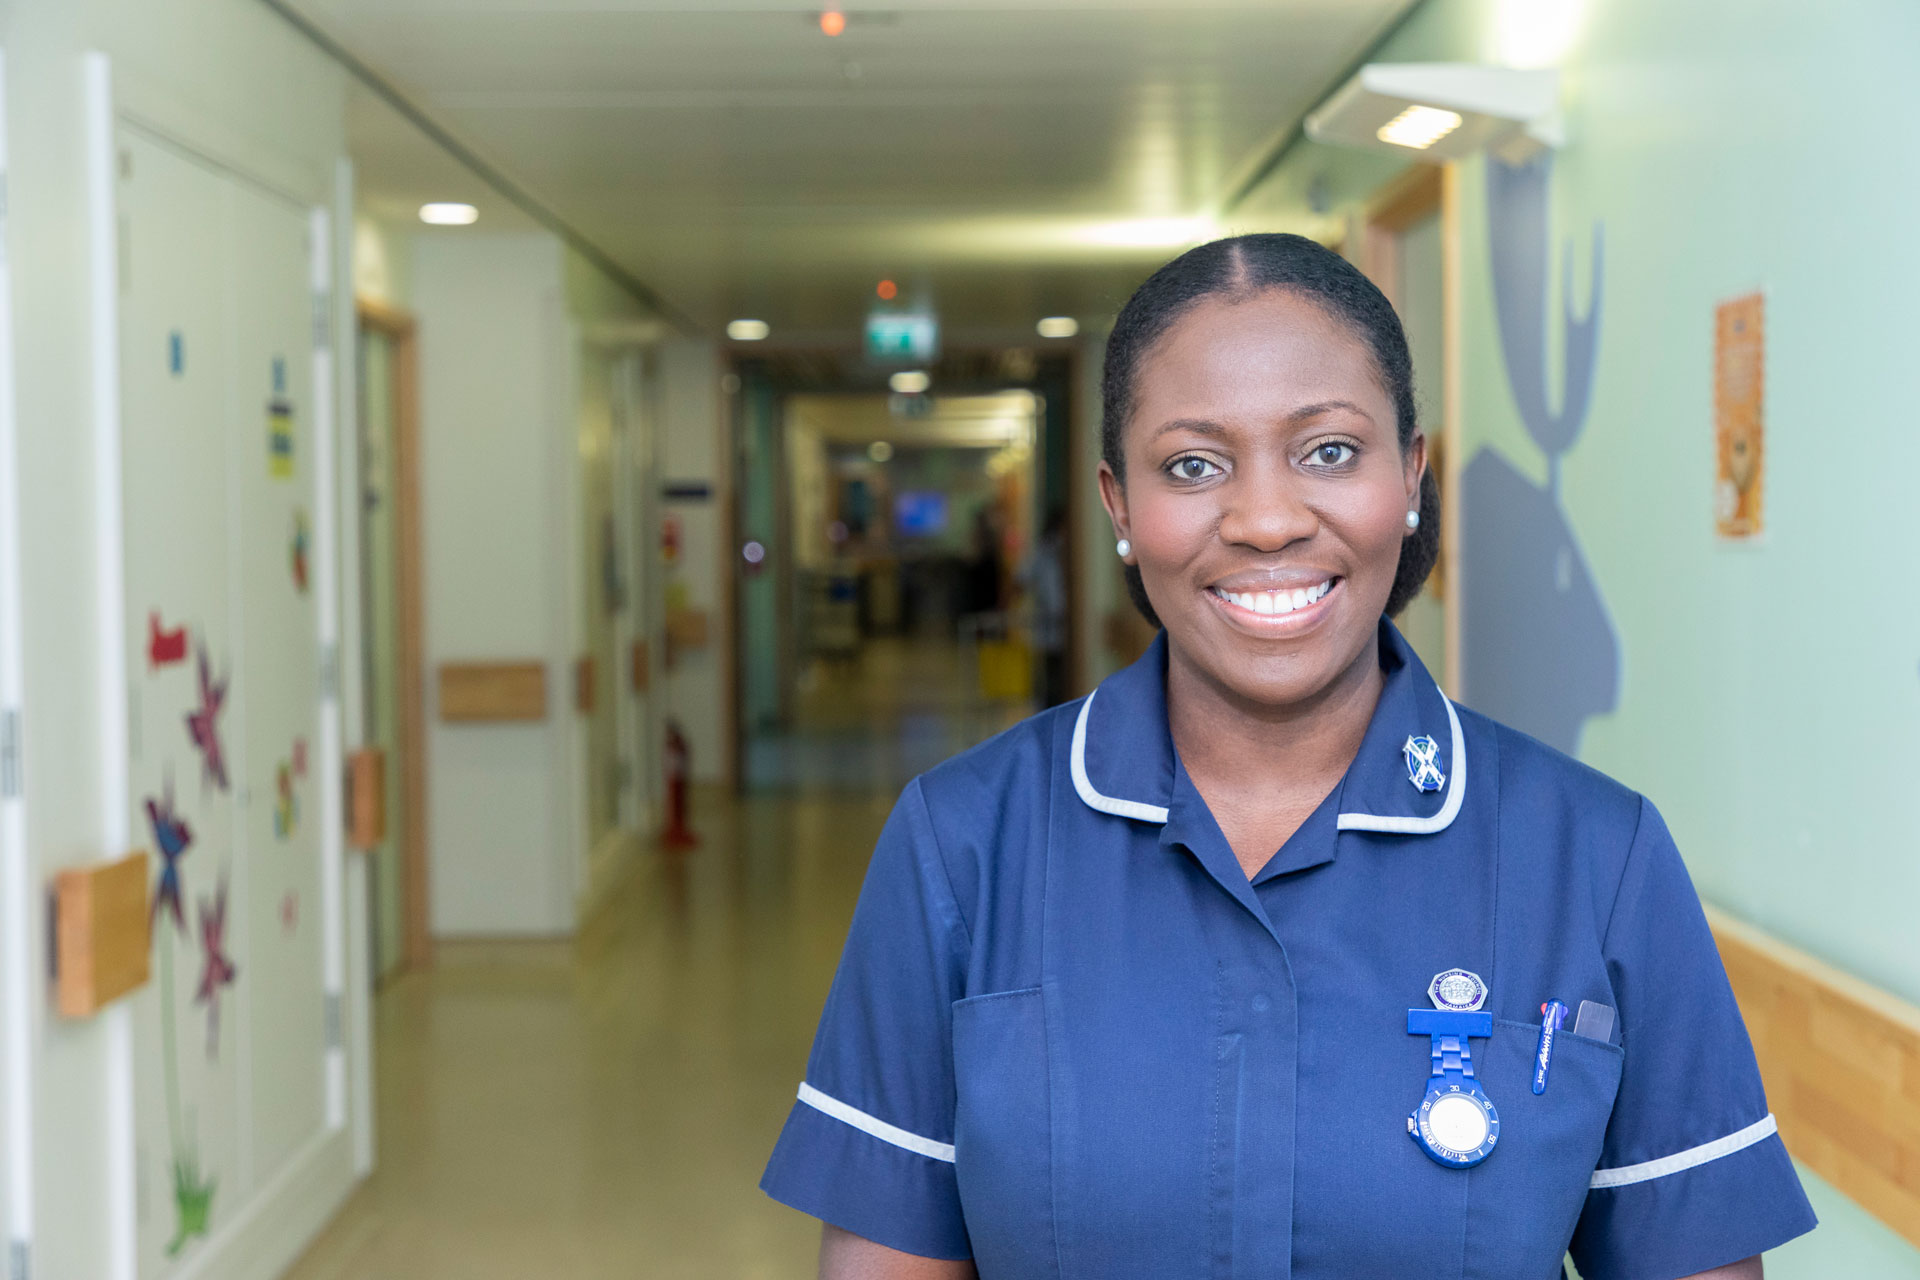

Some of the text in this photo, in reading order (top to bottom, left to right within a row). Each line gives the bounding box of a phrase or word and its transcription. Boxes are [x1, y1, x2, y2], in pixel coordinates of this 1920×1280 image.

[1422, 1101, 1431, 1111] 20
[1483, 1100, 1493, 1110] 40
[1487, 1134, 1497, 1145] 50
